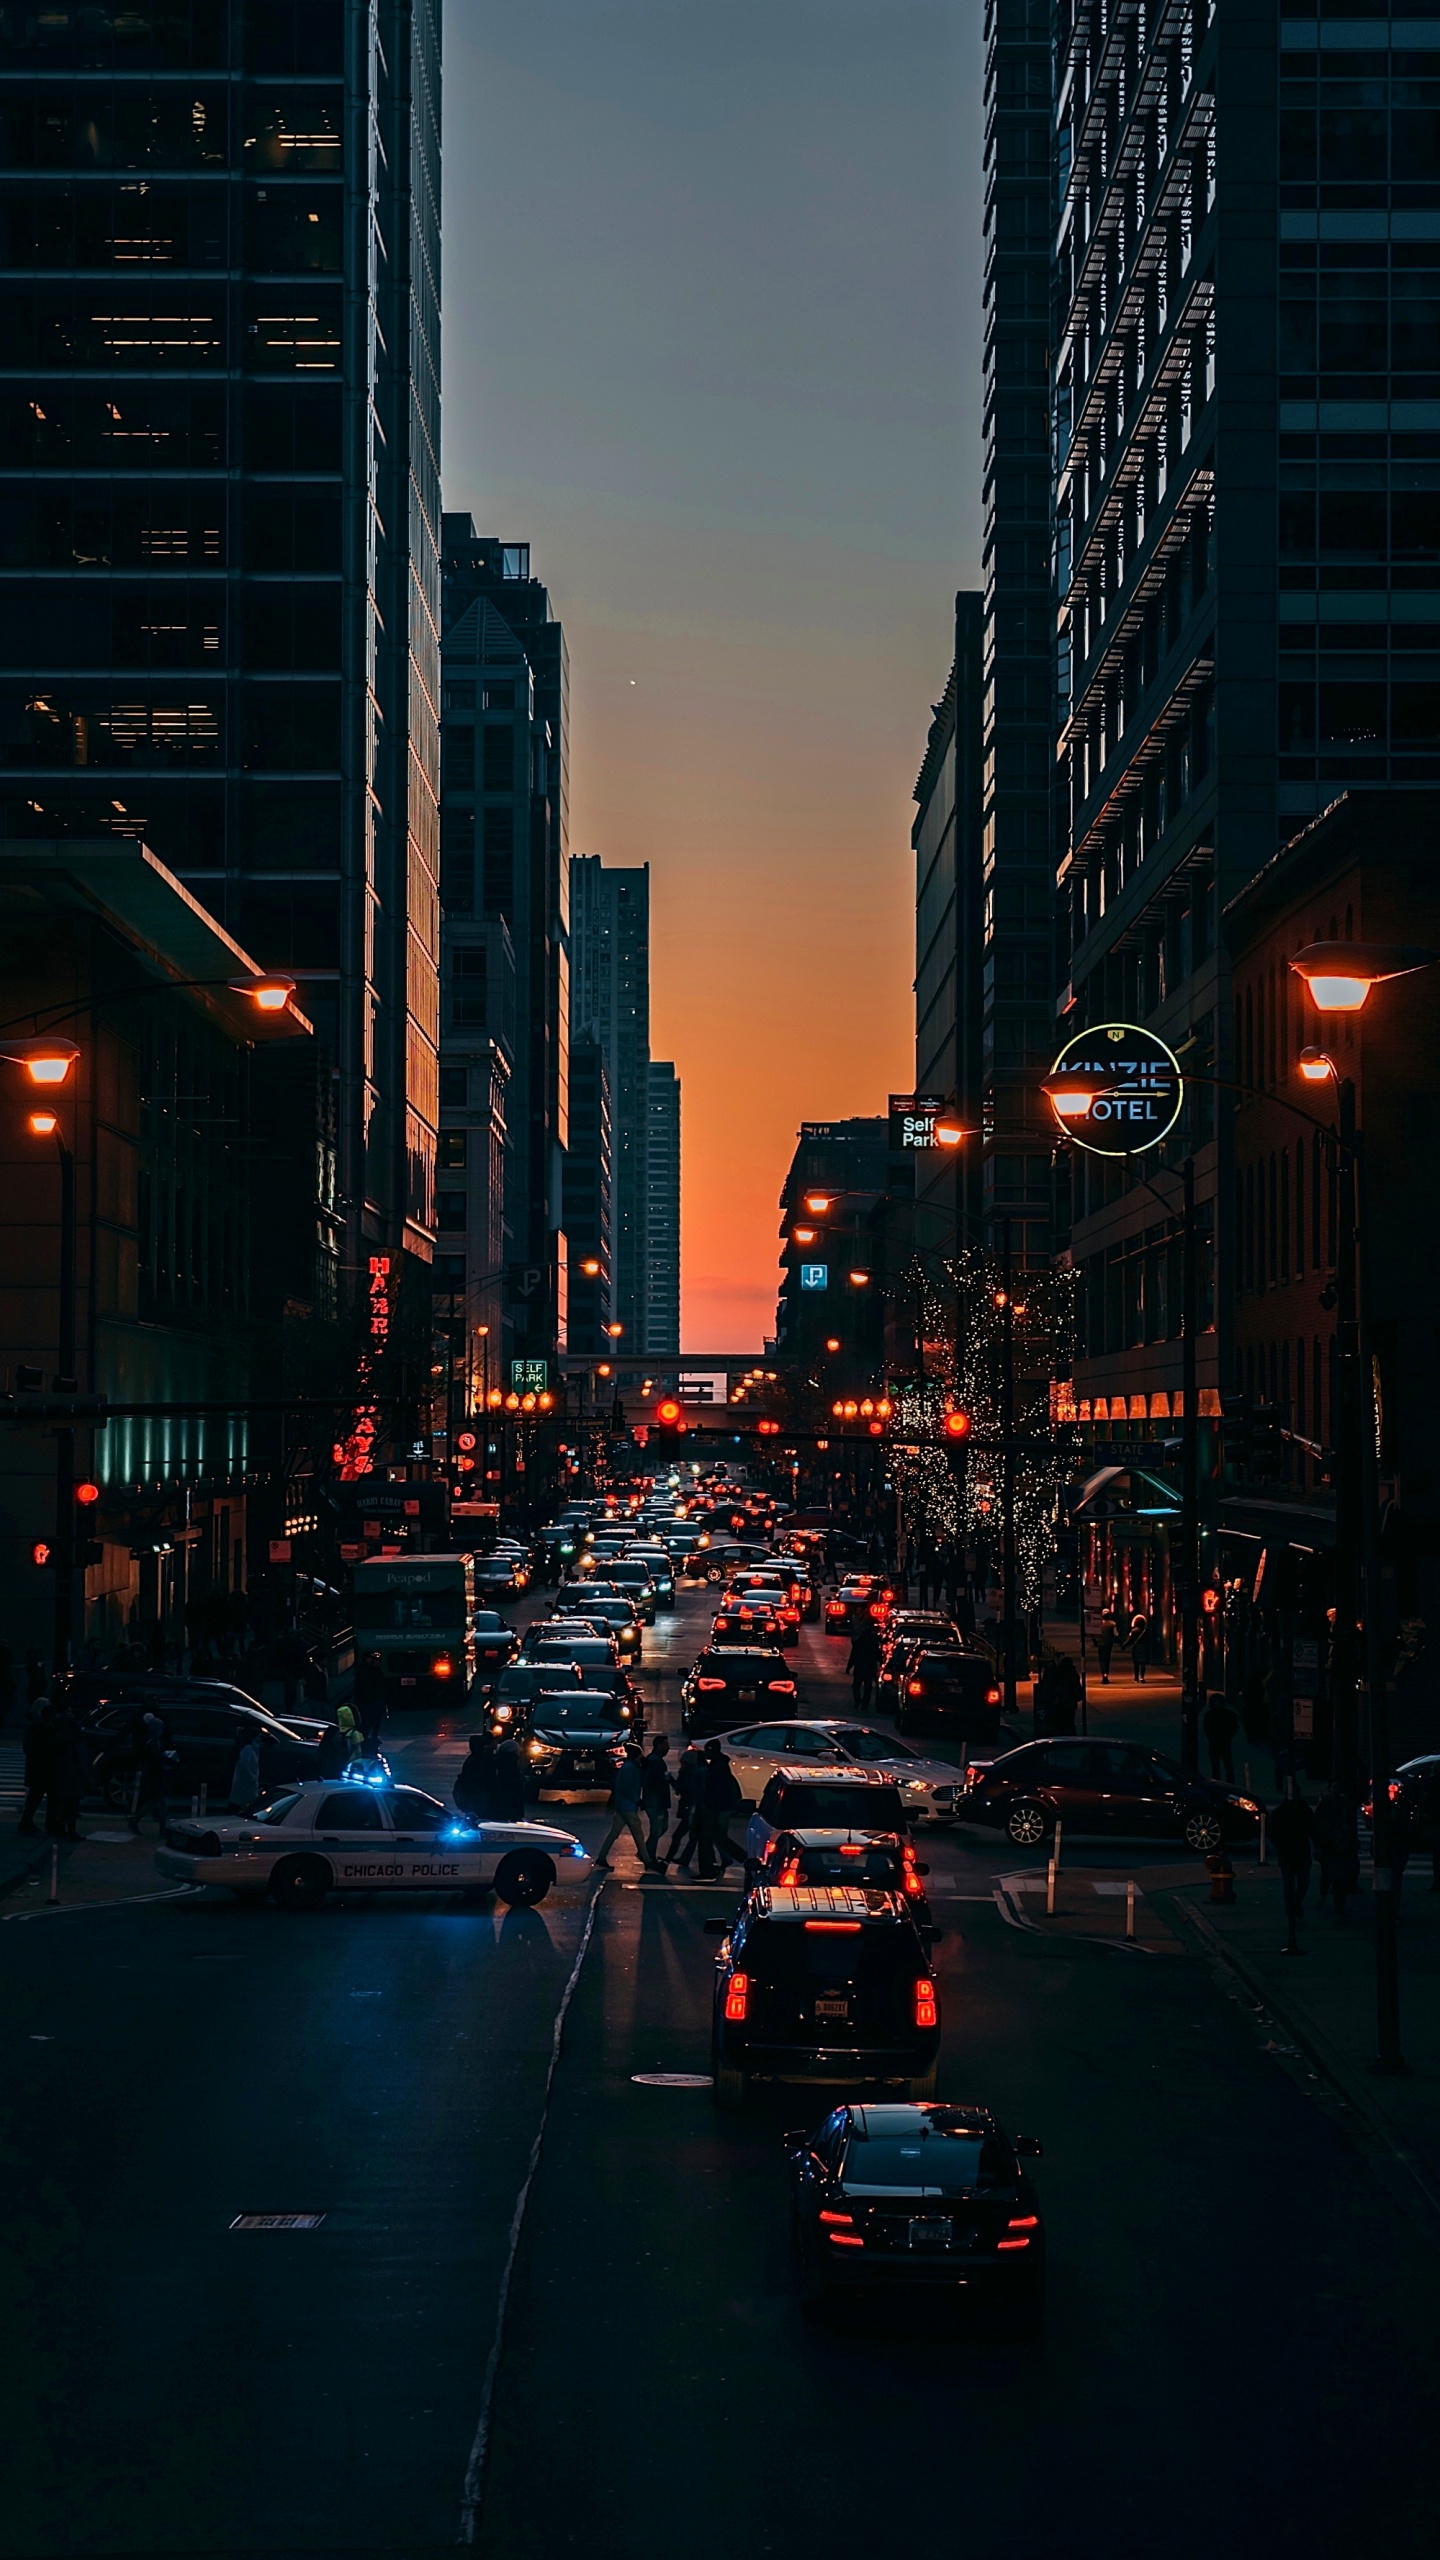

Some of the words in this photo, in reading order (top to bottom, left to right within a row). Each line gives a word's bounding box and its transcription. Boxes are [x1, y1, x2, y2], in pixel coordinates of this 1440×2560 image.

[1073, 1101, 1158, 1121] OTEL
[903, 1116, 936, 1132] Self
[902, 1132, 940, 1147] Park
[1110, 1444, 1144, 1455] STATE
[1151, 1446, 1161, 1454] ST
[387, 1571, 431, 1586] Peapod
[344, 1865, 404, 1877] CHICAGO
[412, 1864, 460, 1876] POLICE
